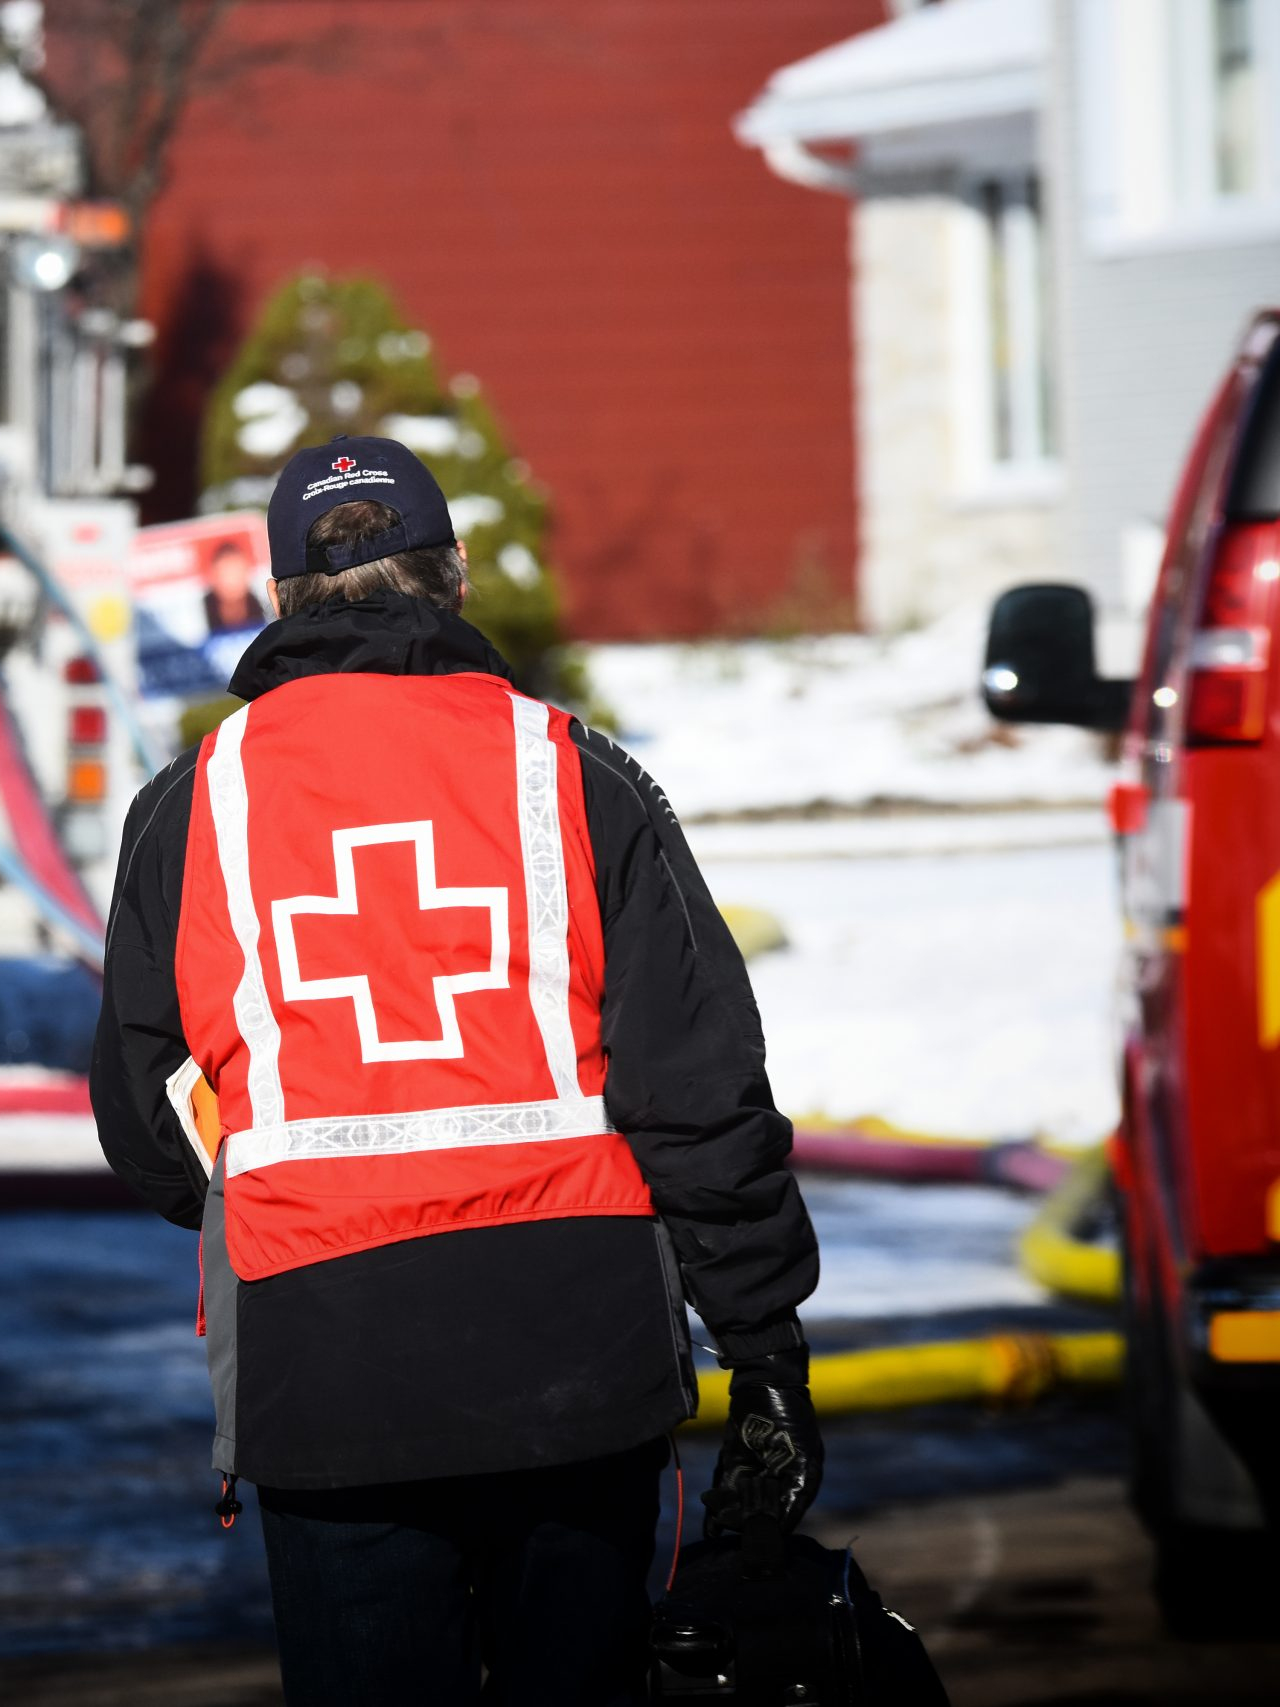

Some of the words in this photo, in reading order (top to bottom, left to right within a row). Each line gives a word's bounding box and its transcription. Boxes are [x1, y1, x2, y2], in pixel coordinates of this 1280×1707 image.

[302, 481, 348, 500] Croix-Rouge
[349, 476, 395, 485] canadienne
[307, 475, 343, 490] Canadian
[344, 470, 360, 479] Red
